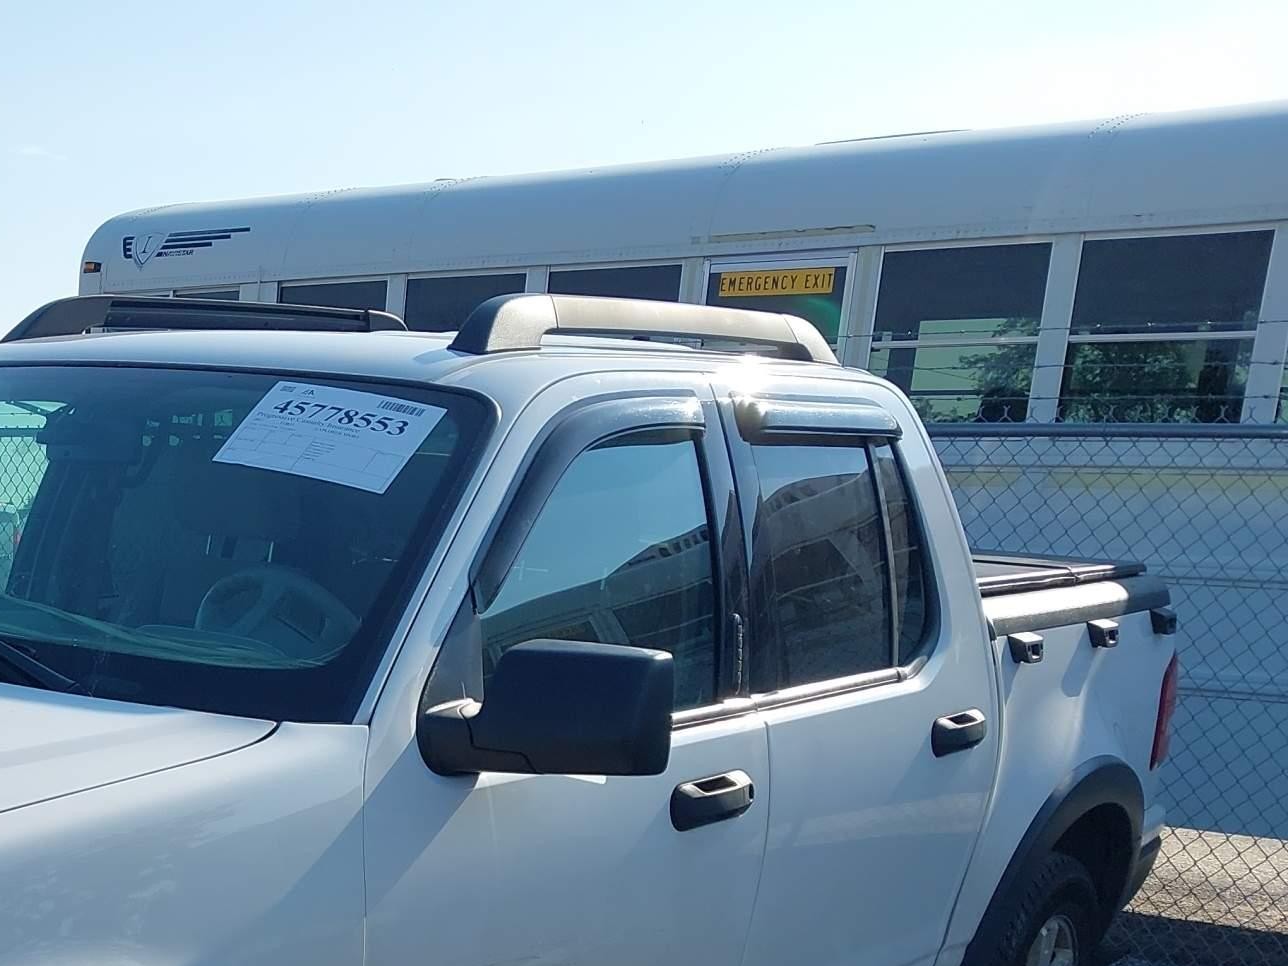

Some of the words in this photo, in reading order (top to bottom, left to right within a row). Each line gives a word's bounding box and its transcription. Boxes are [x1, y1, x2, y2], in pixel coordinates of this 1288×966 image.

[720, 275, 799, 292] EMERGENCY
[804, 273, 834, 289] EXIT
[273, 399, 409, 437] 45778553
